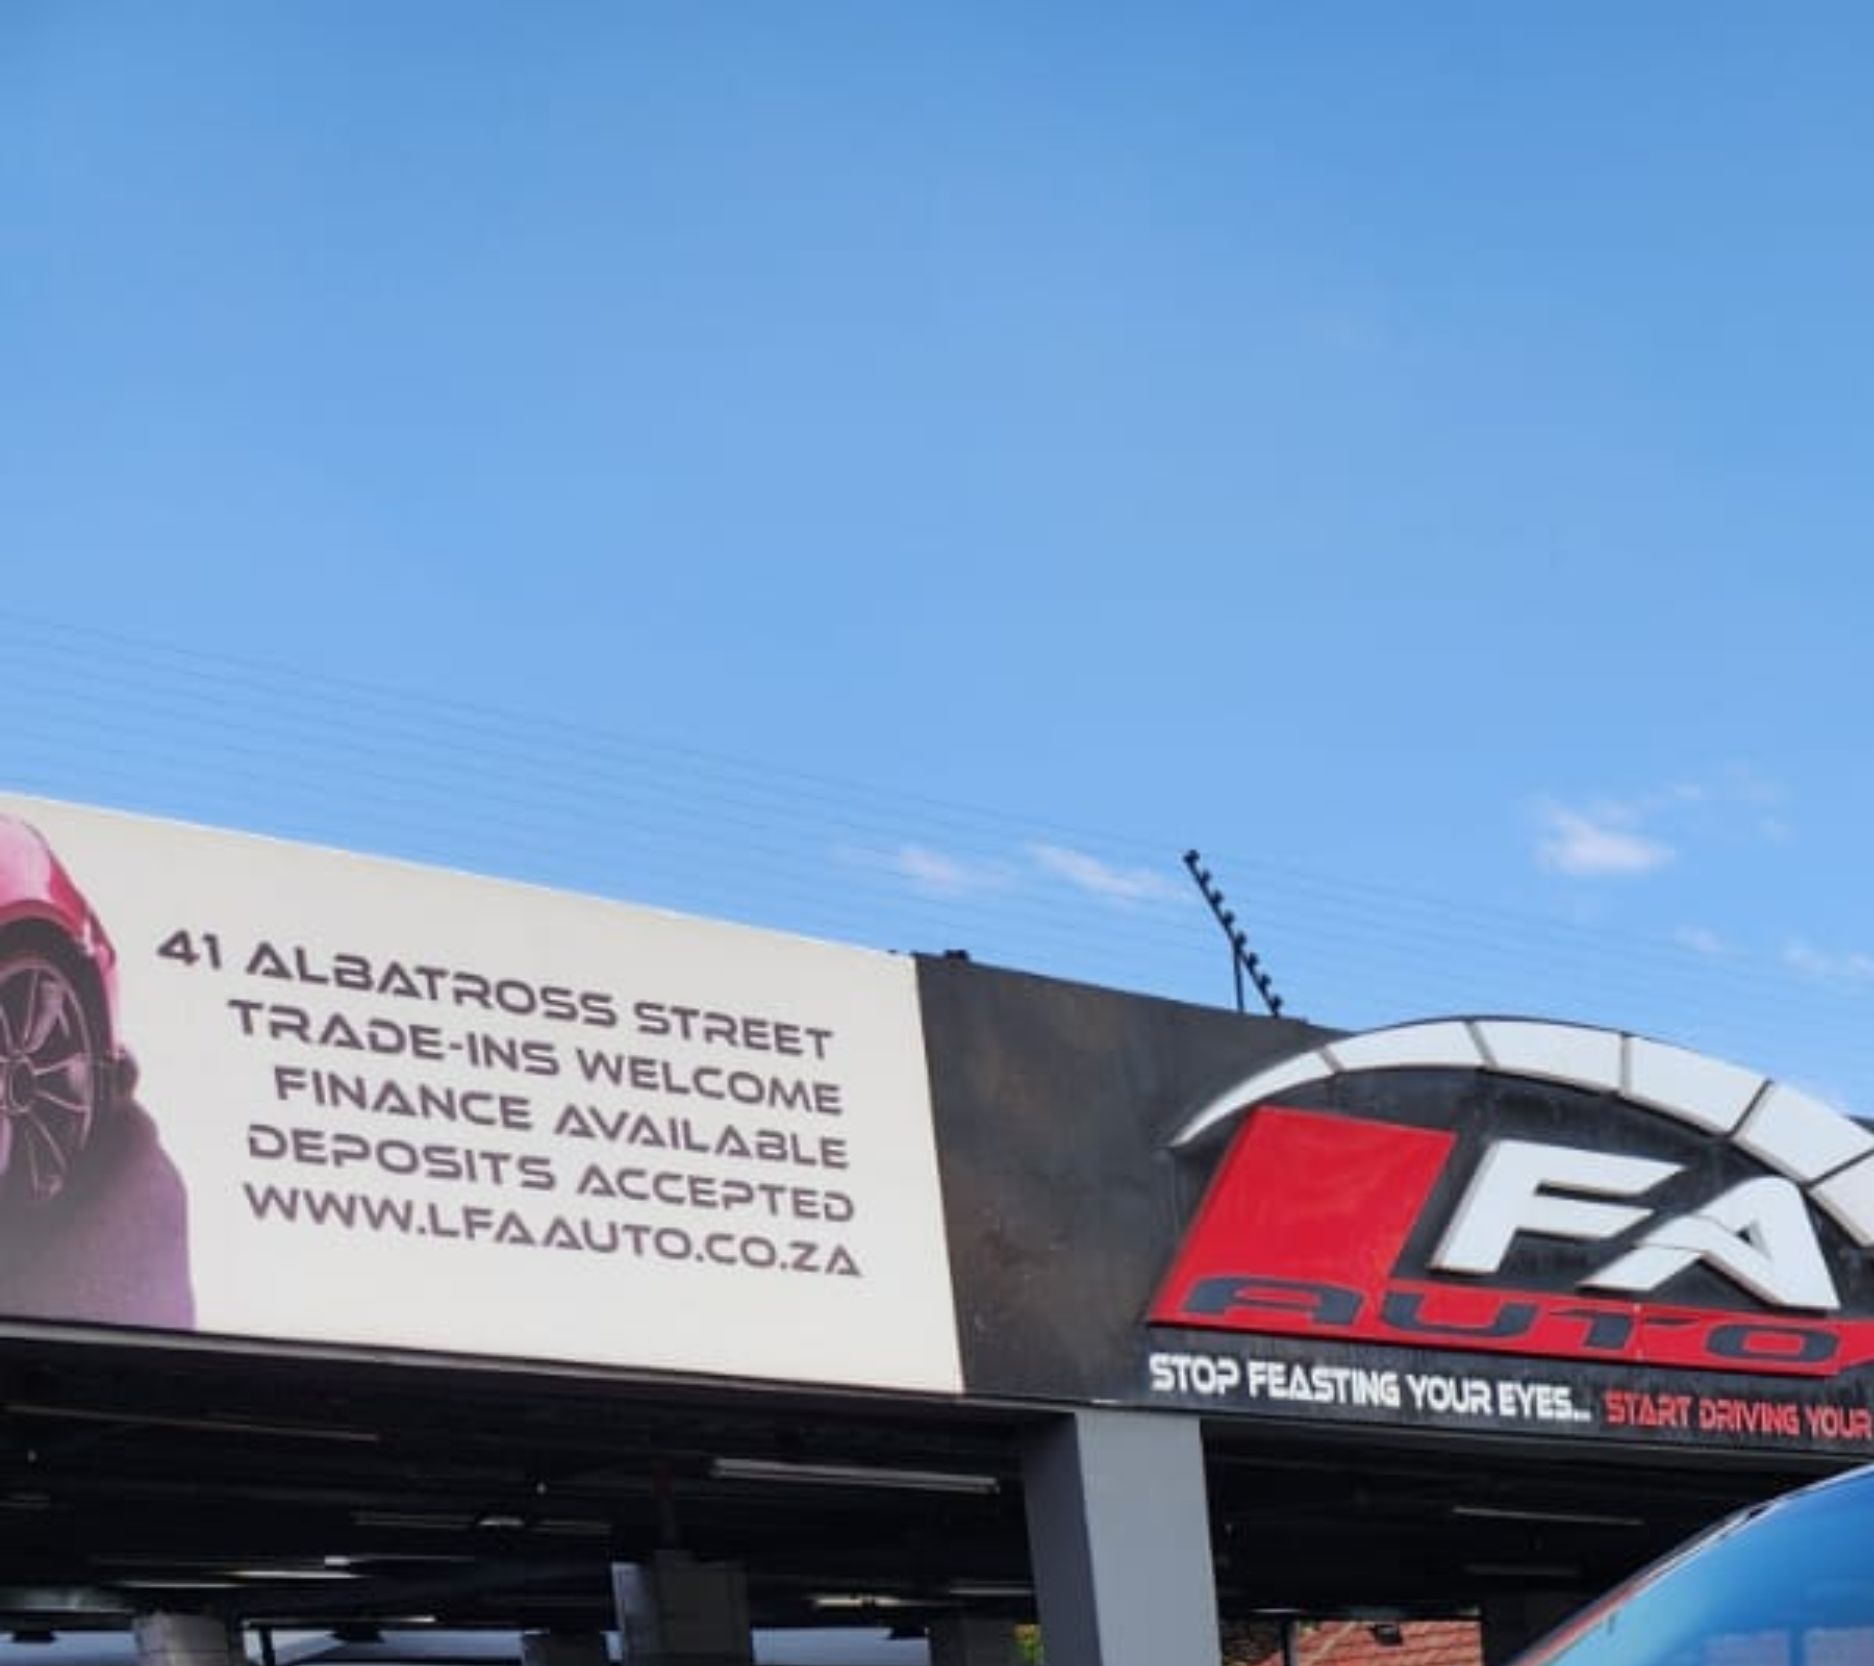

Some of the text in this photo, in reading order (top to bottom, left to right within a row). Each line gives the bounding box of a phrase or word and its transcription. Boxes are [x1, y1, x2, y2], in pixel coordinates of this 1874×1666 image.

[156, 929, 833, 1060] 41 ALBATROSS STREET
[226, 998, 843, 1116] TRADE-INS WELCOME
[273, 1065, 849, 1170] FINANCE AVAILABLE
[247, 1123, 855, 1223] DEPOSITS ACCEPTED
[243, 1183, 860, 1277] WWW.LFAAUTO.CO.ZA
[1180, 1274, 1842, 1365] AUTO
[1148, 1352, 1241, 1395] STOP
[1247, 1360, 1401, 1408] FEASTING
[1405, 1374, 1493, 1416] YOUR
[1605, 1390, 1692, 1429] START
[1699, 1398, 1801, 1439] DRIVING
[1805, 1406, 1873, 1444] YOUR
